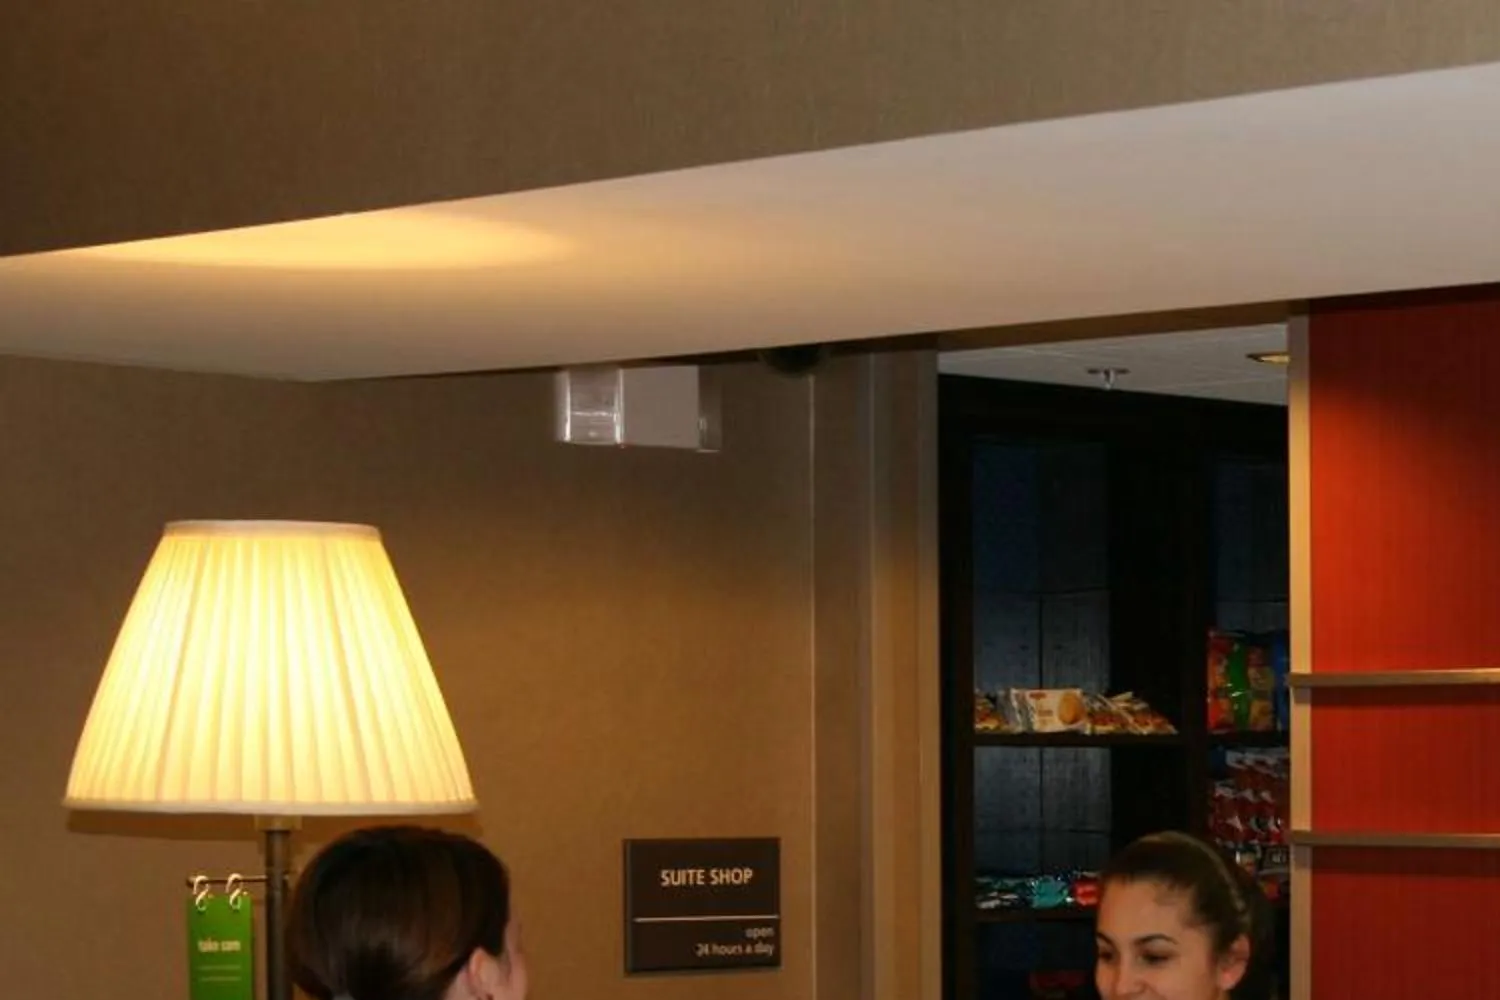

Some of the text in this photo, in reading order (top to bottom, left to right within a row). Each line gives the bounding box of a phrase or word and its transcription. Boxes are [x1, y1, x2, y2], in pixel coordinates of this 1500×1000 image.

[660, 867, 754, 888] SUITE SHOP
[745, 927, 775, 940] open
[711, 942, 743, 956] hours
[754, 941, 775, 957] day
